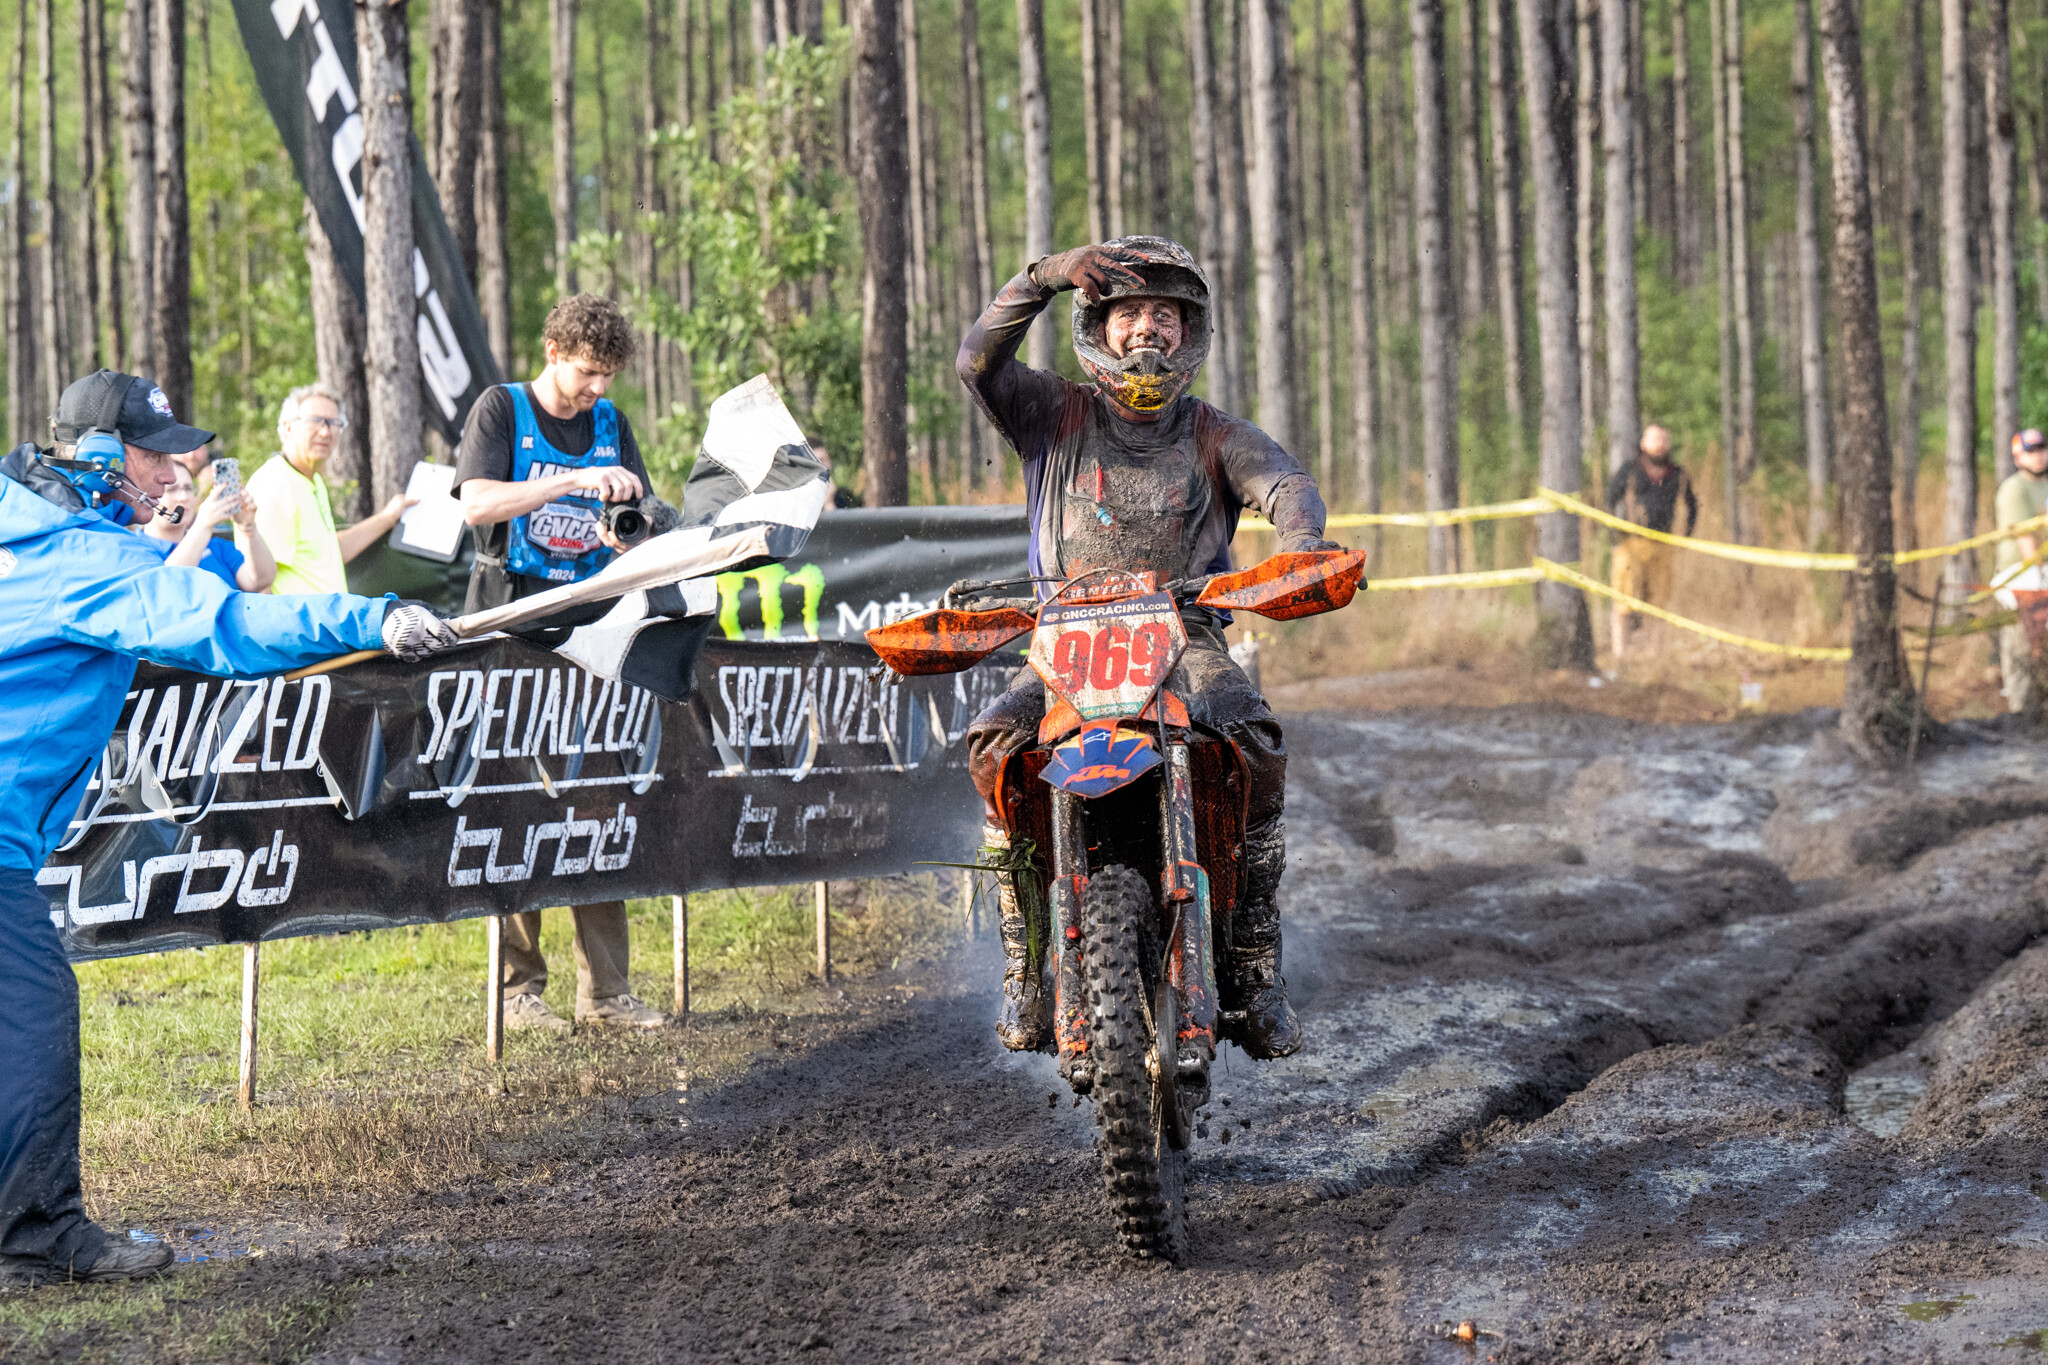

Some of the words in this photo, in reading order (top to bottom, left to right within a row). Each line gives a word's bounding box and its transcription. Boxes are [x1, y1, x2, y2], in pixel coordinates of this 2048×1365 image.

[532, 515, 597, 542] GNCC
[547, 567, 576, 581] 2024
[1061, 602, 1170, 620] GNCCRACING.COM
[1052, 621, 1170, 695] 969
[417, 667, 652, 764] SPECIALIZED
[1063, 764, 1131, 787] KTM
[448, 802, 637, 887] turbo
